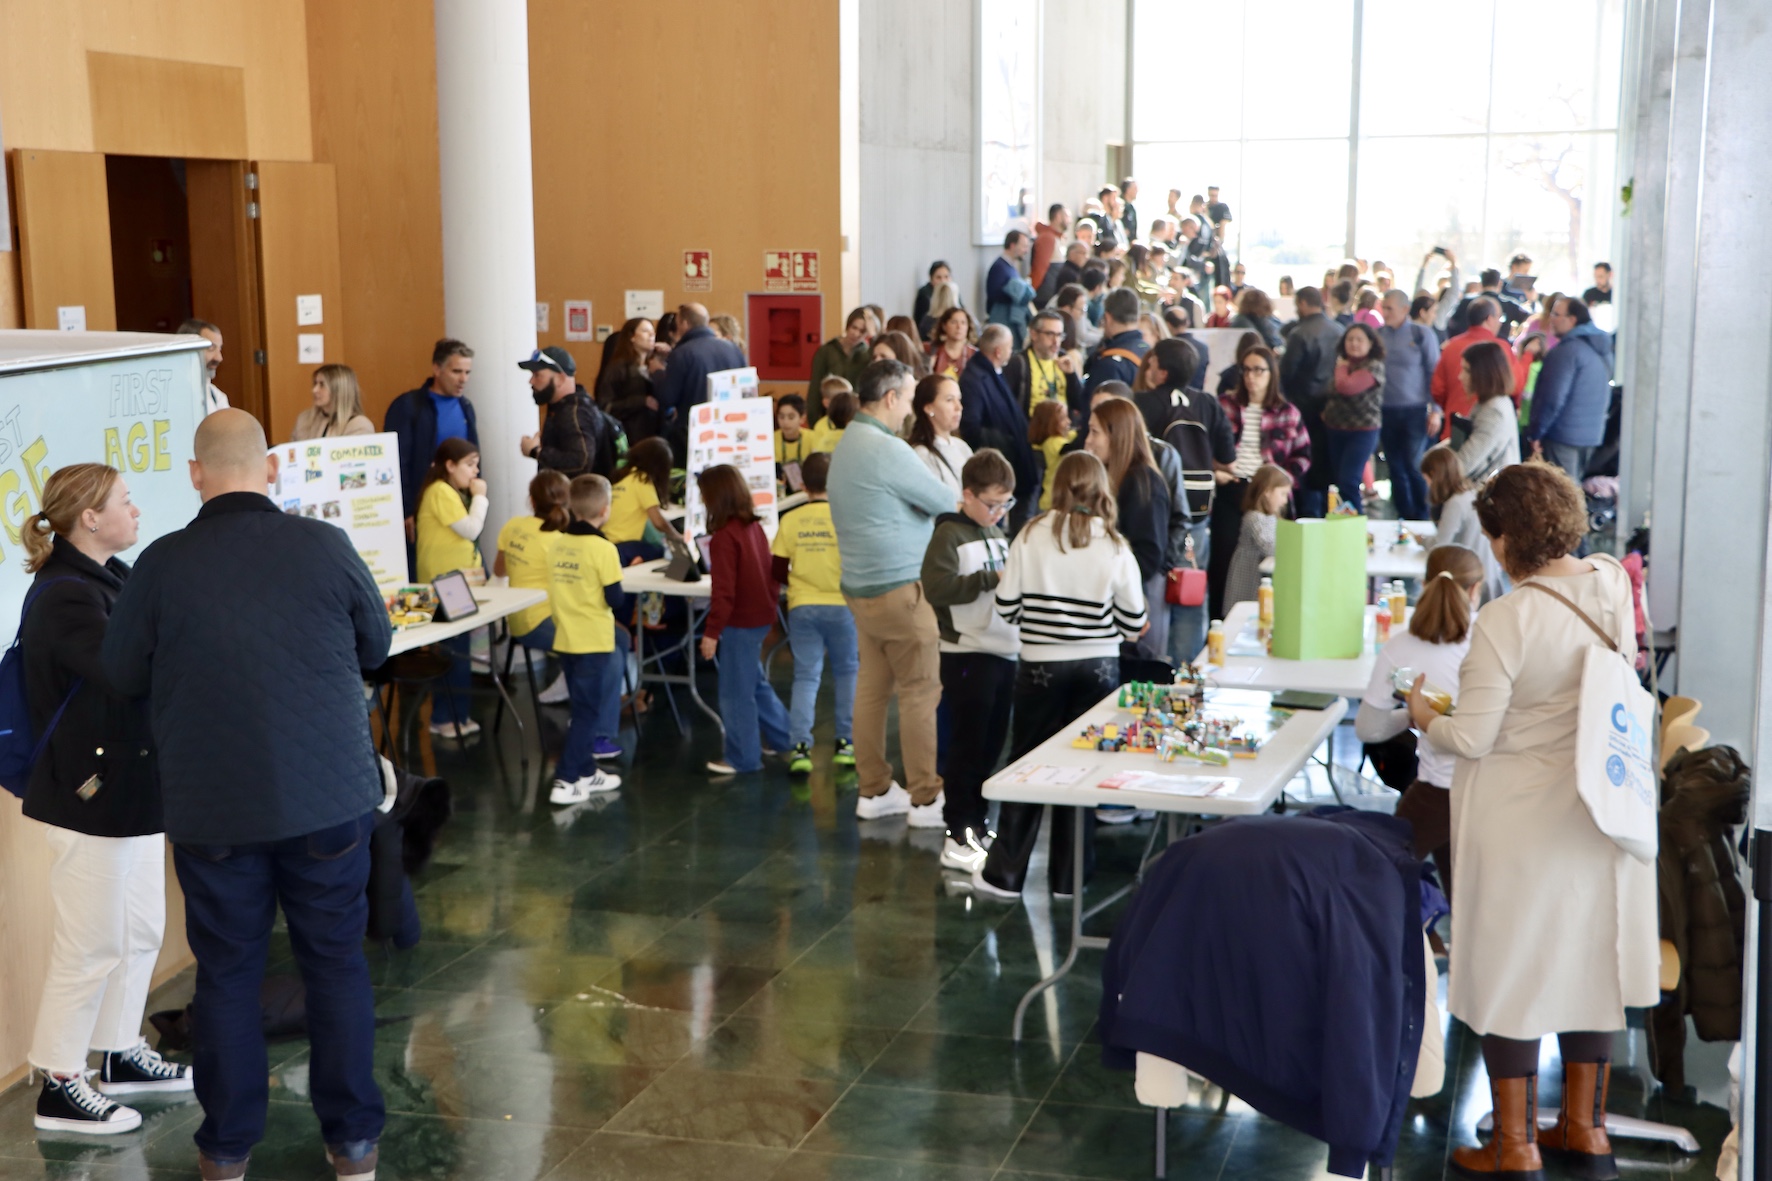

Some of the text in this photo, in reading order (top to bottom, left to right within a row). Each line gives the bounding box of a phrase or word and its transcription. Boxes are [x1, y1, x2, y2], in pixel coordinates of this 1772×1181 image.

[109, 369, 173, 418] FIRST
[104, 419, 172, 473] AGE
[797, 530, 834, 539] DANIEL
